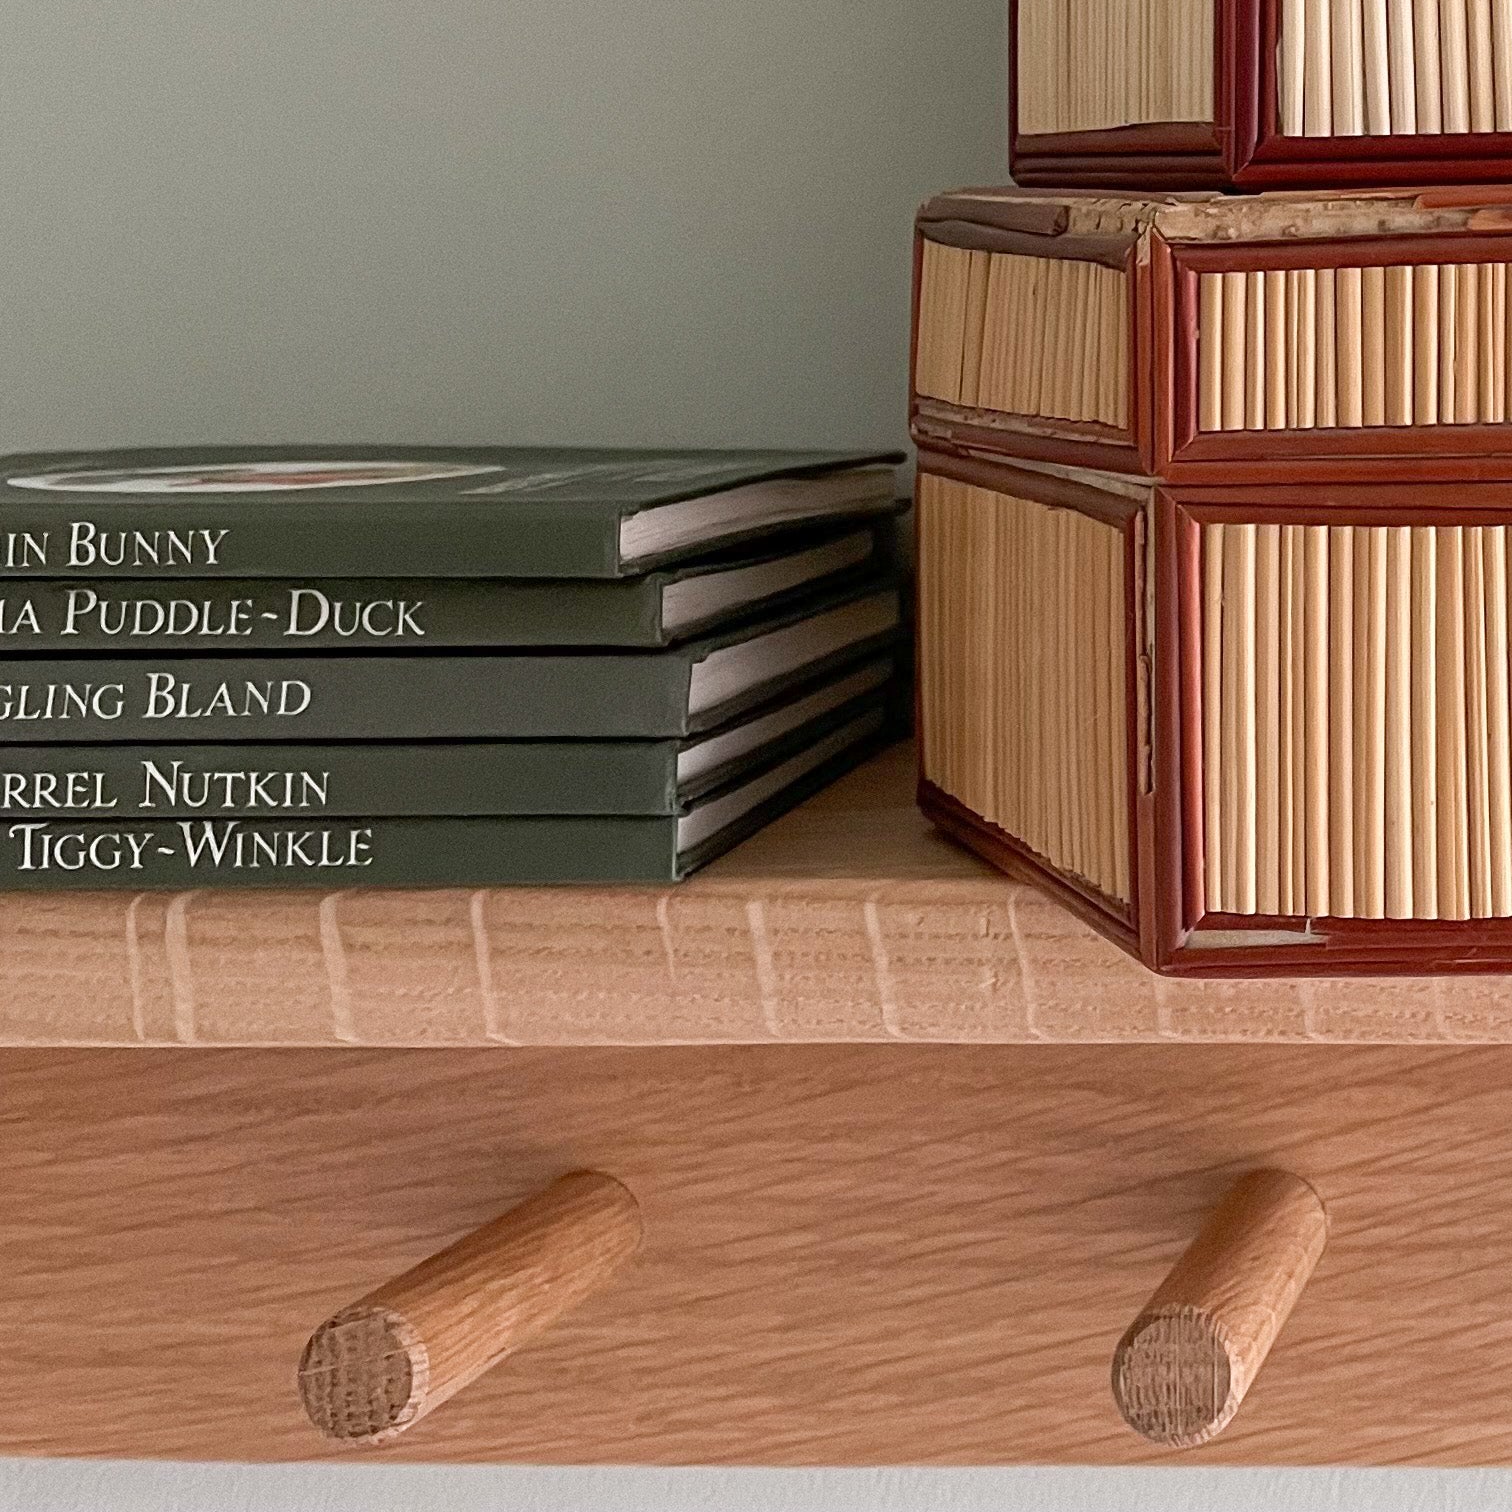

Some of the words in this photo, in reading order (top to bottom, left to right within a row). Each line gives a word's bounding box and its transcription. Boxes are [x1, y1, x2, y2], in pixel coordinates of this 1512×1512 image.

[4, 532, 49, 568] IN
[66, 521, 229, 567] BUNNY
[0, 599, 42, 635] A
[60, 589, 426, 636] PUDDLE-DUCK
[142, 672, 311, 719] BLAND
[0, 771, 118, 809] RREL
[138, 760, 330, 808] NUTKIN
[8, 821, 374, 870] TIGGY-WINKLE
